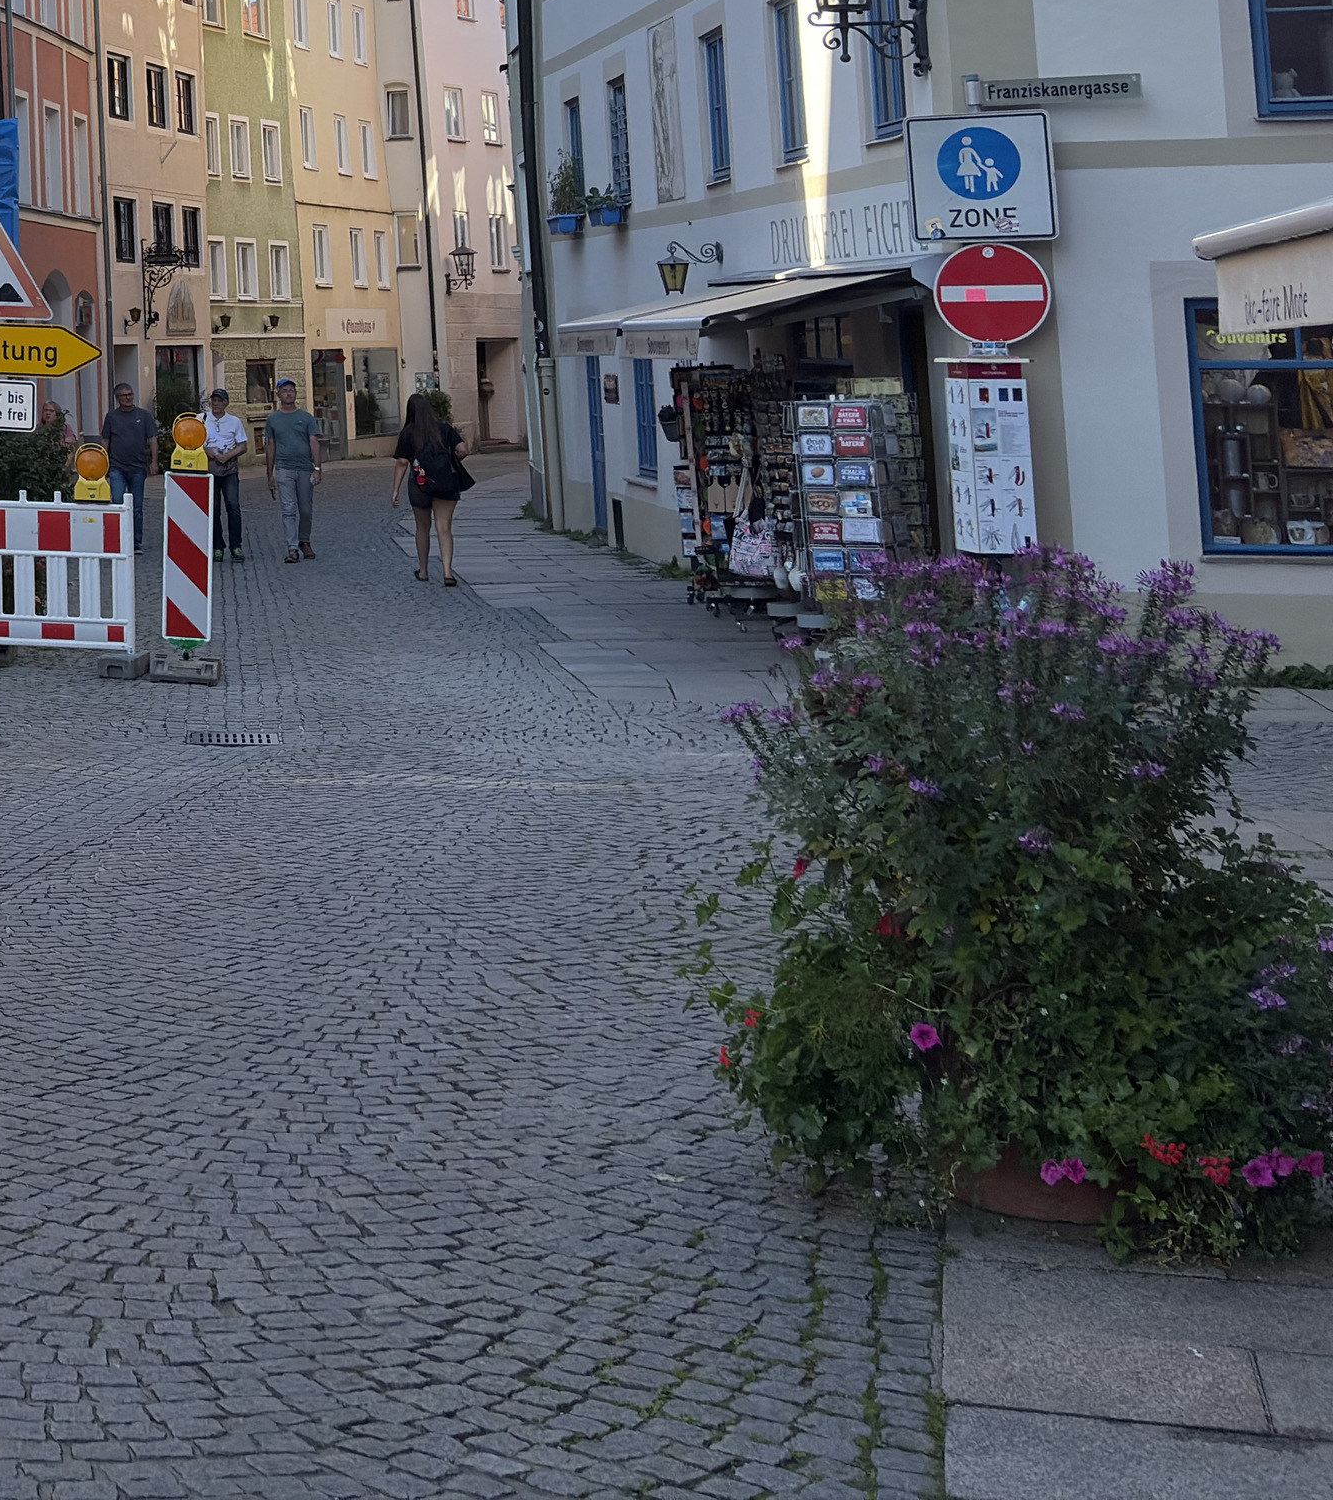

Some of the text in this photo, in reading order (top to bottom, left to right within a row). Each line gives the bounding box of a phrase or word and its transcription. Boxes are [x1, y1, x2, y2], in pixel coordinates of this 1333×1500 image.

[988, 80, 1129, 100] Franziskanergasse
[770, 200, 928, 265] DRUCKEREI FICHT
[1282, 282, 1308, 320] Mode
[8, 391, 25, 404] bis
[8, 408, 27, 421] frei
